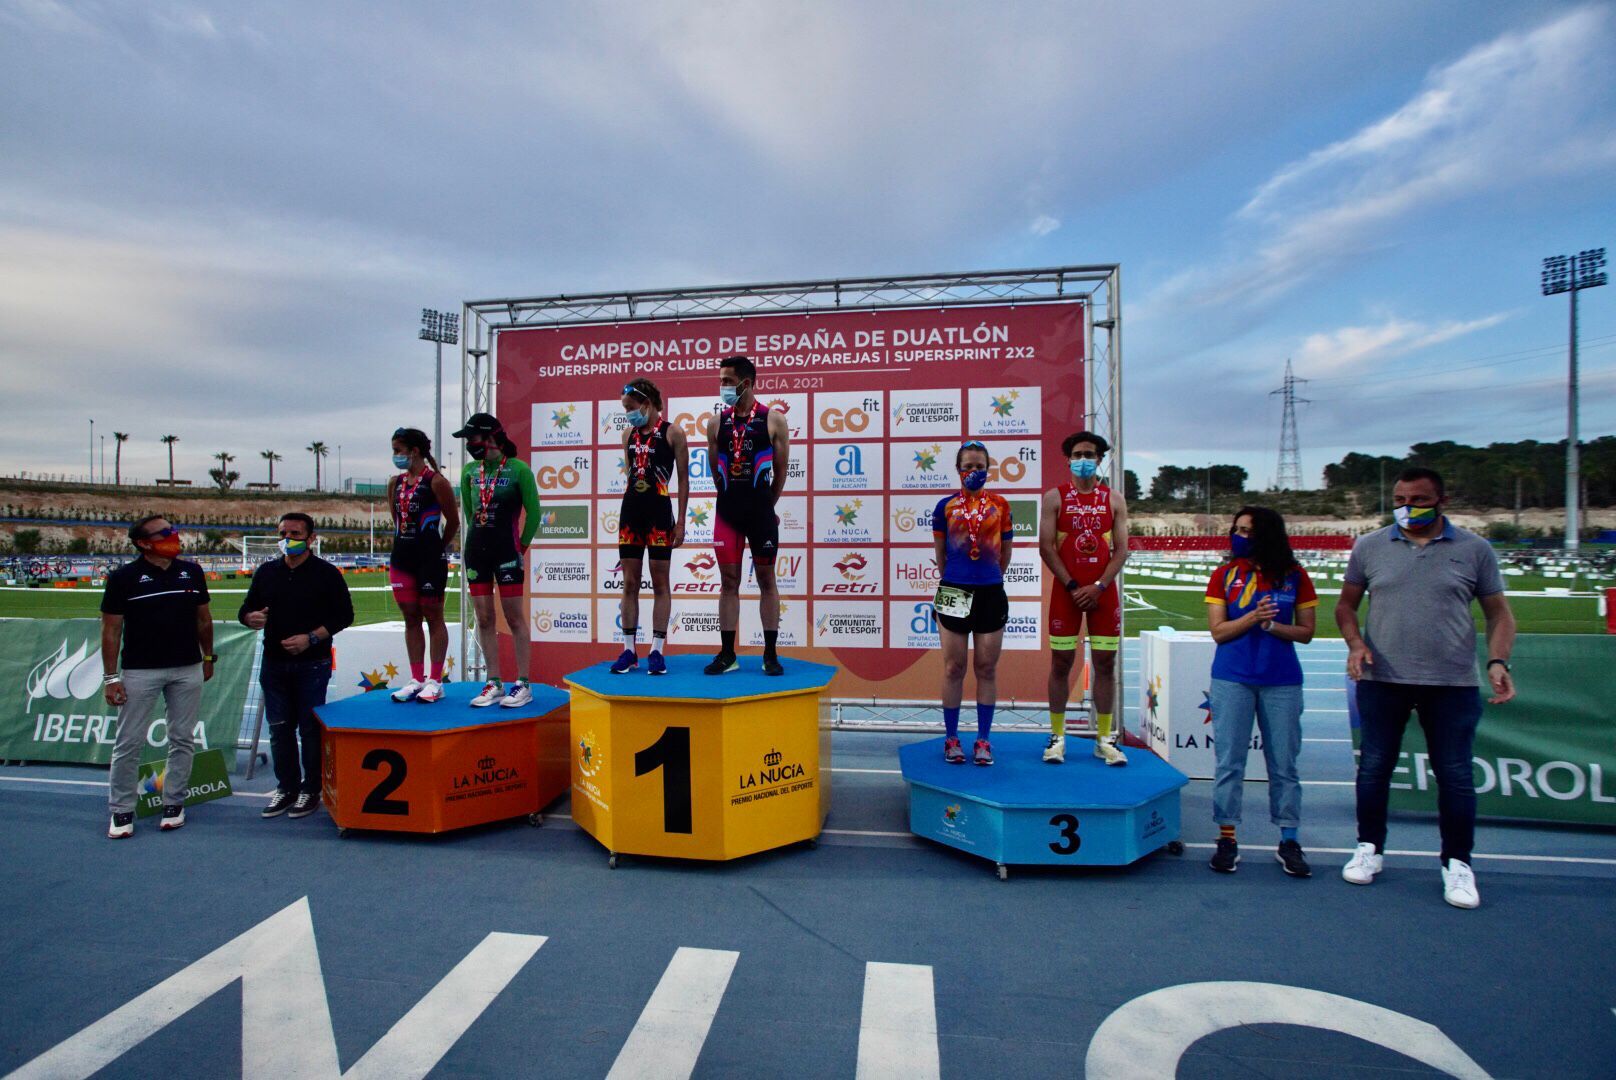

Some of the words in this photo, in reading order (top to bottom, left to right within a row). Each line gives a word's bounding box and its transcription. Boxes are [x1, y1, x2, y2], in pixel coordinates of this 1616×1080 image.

[560, 338, 711, 361] CAMPEONATO
[718, 336, 748, 354] DE
[755, 327, 847, 352] ESPAÑA
[854, 330, 885, 348] DE
[892, 321, 1009, 347] DUATLÓN
[538, 361, 630, 377] SUPERSPRINT
[634, 360, 664, 373] POR
[667, 357, 721, 371] CLUBES
[748, 351, 881, 368] ELEVOS/PAREJAS
[894, 347, 1000, 363] SUPERSPRINT
[1004, 346, 1035, 359] 2X2
[753, 376, 789, 390] UCÍA
[793, 377, 824, 389] 2021
[819, 408, 870, 433] GO
[862, 398, 880, 412] fit
[905, 407, 954, 416] COMUNITAT
[921, 414, 960, 423] L'ESPORT
[1018, 447, 1036, 461] fit
[536, 465, 580, 490] GO
[574, 457, 589, 470] fit
[542, 526, 584, 534] IBERDROLA
[559, 612, 588, 620] Costa
[829, 618, 876, 627] COMUNITAT
[553, 619, 588, 629] Blanca
[685, 624, 695, 632] DE
[696, 624, 721, 632] L'ESPO
[844, 626, 882, 634] L'ESPORT
[1176, 734, 1198, 748] LA
[361, 748, 409, 816] 2
[453, 775, 471, 789] LA
[634, 726, 693, 834] 1
[740, 773, 756, 790] LA
[731, 795, 753, 806] PREMIO
[753, 789, 780, 801] NACIONAL
[780, 787, 790, 795] DEL
[791, 780, 814, 792] DEPORTE
[1049, 813, 1081, 855] 3
